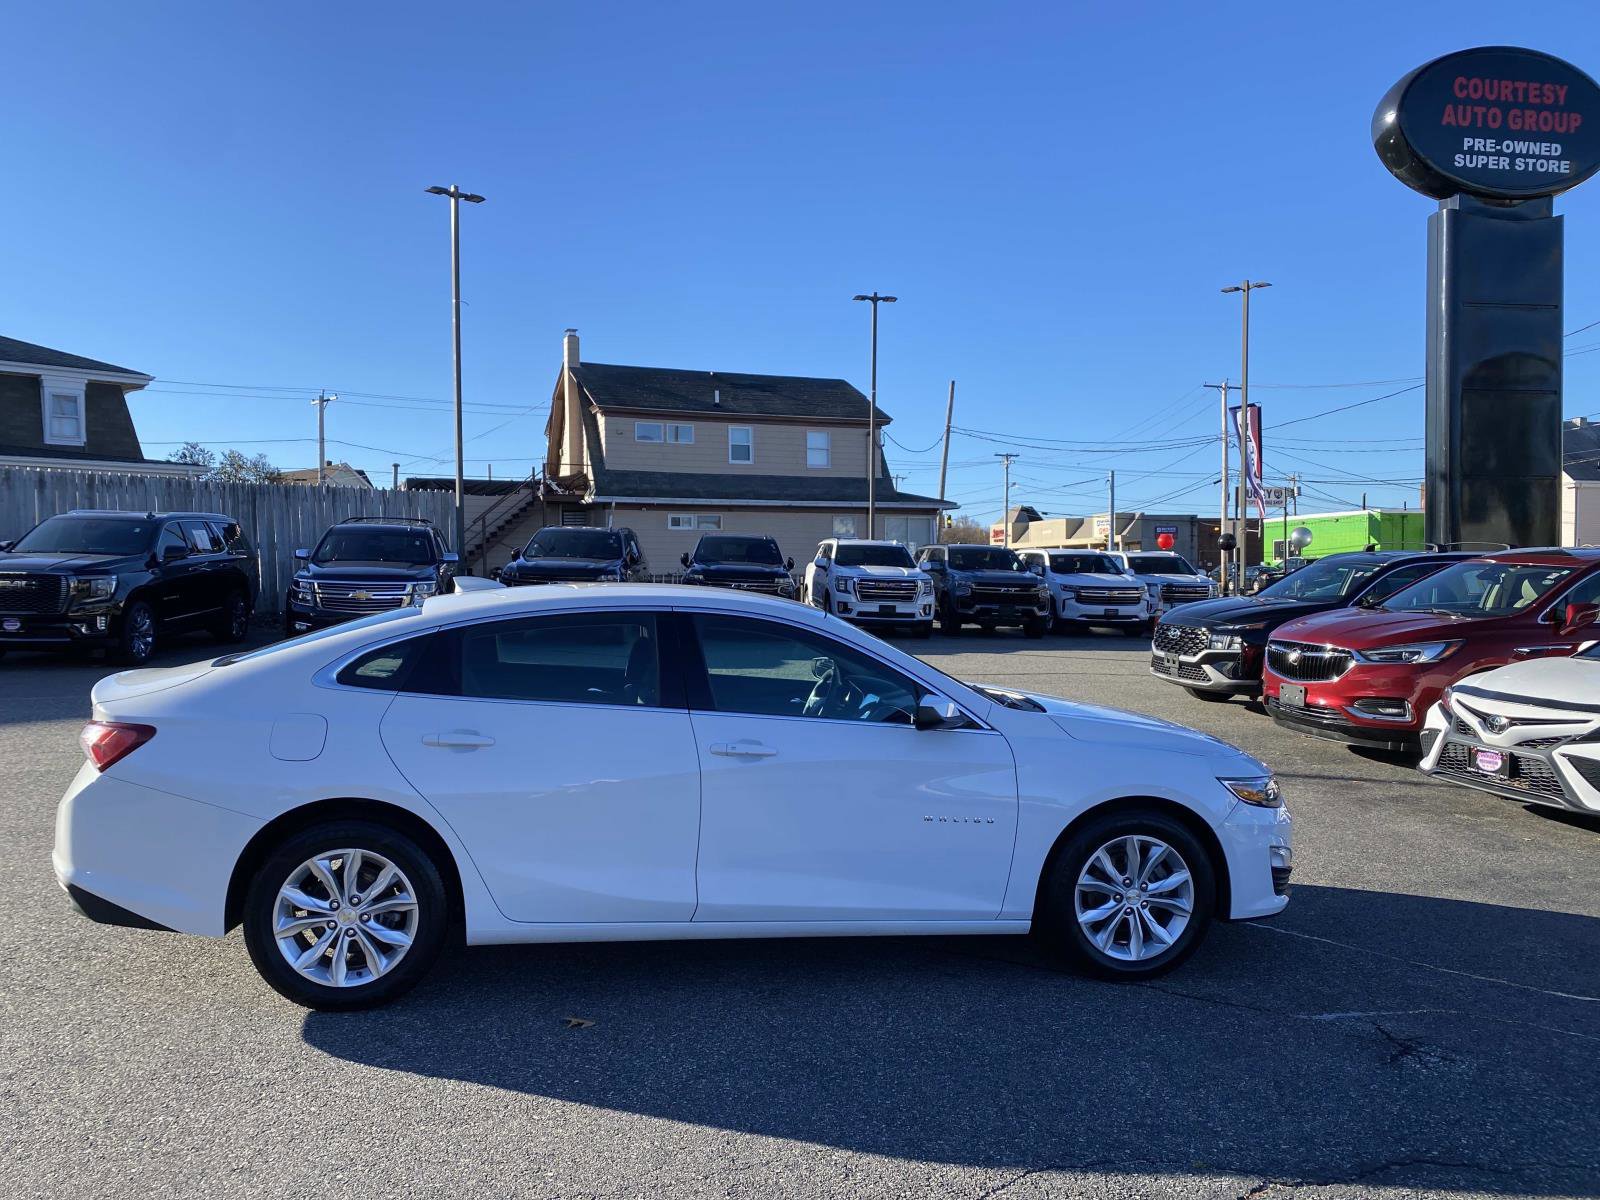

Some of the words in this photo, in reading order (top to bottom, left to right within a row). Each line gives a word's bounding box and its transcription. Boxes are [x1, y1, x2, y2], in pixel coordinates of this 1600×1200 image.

[1453, 76, 1568, 106] COURTESY
[1441, 104, 1502, 129] AUTO
[1507, 108, 1582, 133] GROUP
[1463, 137, 1562, 156] PRE-OWNED
[1454, 154, 1510, 170] SUPER
[1515, 158, 1571, 174] STORE
